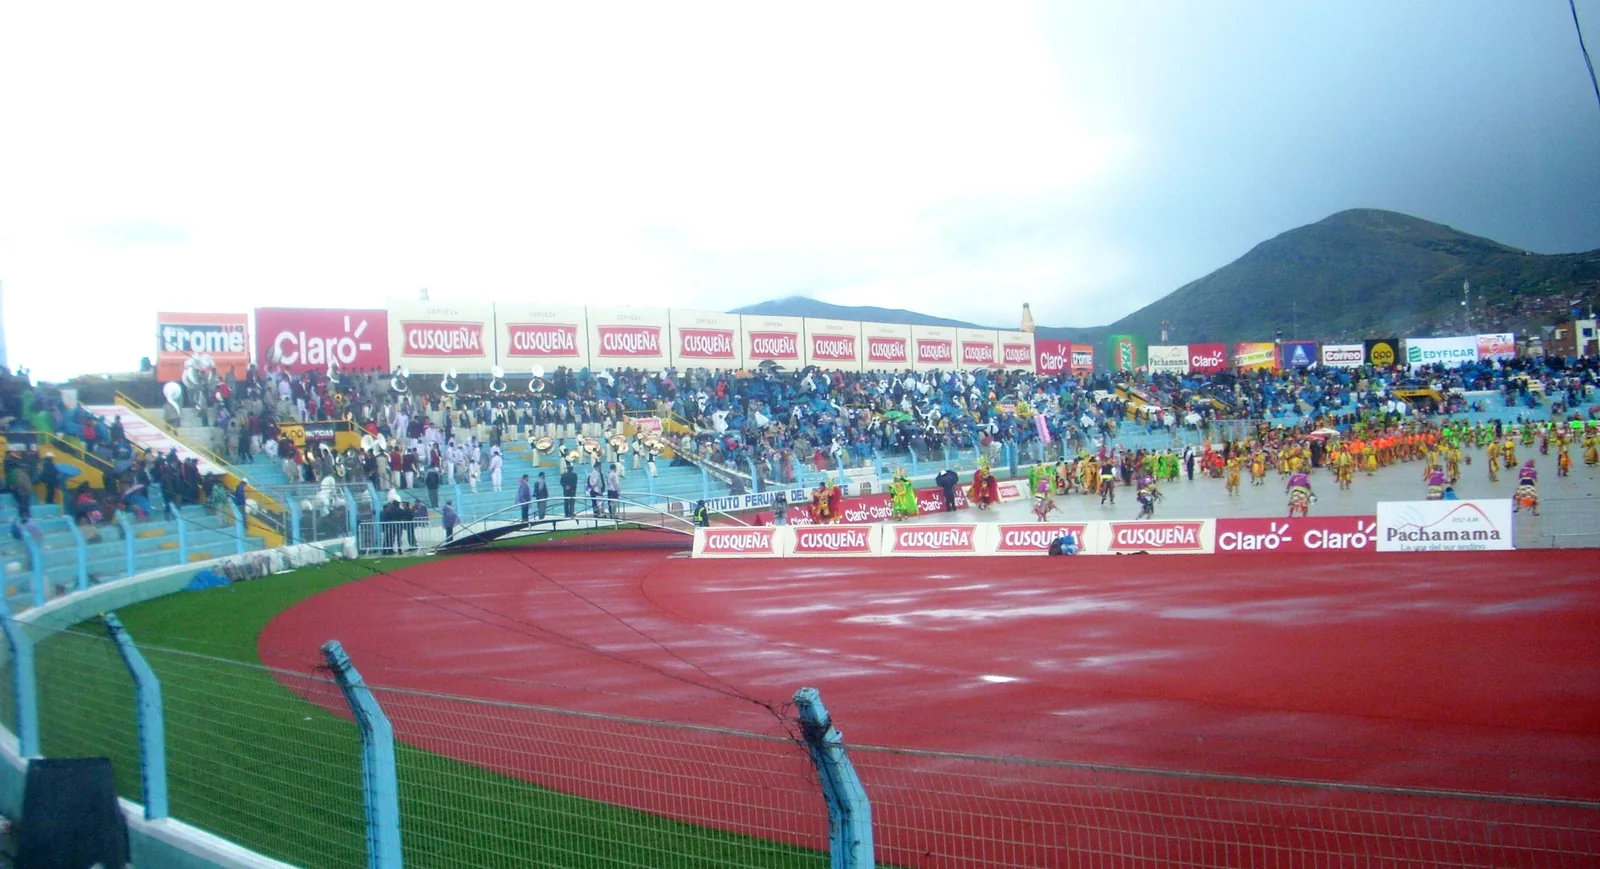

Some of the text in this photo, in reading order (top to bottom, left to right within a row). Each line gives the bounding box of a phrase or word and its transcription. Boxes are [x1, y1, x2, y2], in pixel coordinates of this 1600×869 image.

[162, 326, 244, 352] trome
[275, 331, 357, 366] Claro
[409, 327, 478, 353] CUSQUEÑA
[514, 329, 573, 353] CUSQUEÑA
[603, 331, 657, 354] CUSQUEÑA
[684, 333, 731, 354] CUSQUEÑA
[753, 336, 795, 355] CUSQUEÑA
[815, 336, 853, 356] CUSQUEÑA
[871, 339, 904, 358] CUSQUEÑA
[920, 341, 951, 359] CUSQUEÑA
[964, 342, 993, 361] CUSQUEÑA
[1005, 344, 1029, 361] CUSQUEÑA
[1326, 351, 1361, 361] Correo
[1423, 348, 1475, 359] EDYFICAR
[1040, 351, 1064, 370] Claro
[1149, 357, 1188, 366] Pachamama
[1192, 355, 1218, 367] Claro
[791, 489, 808, 501] DEL
[845, 509, 868, 522] Claro
[870, 505, 892, 518] Claro
[921, 500, 942, 512] Claro
[709, 531, 770, 550] CUSQUEÑA
[801, 530, 865, 550] CUSQUEÑA
[900, 529, 969, 550] CUSQUEÑA
[1118, 525, 1195, 546] CUSQUEÑA
[1219, 529, 1366, 550] Claro Claro
[1387, 527, 1501, 542] Pachamama
